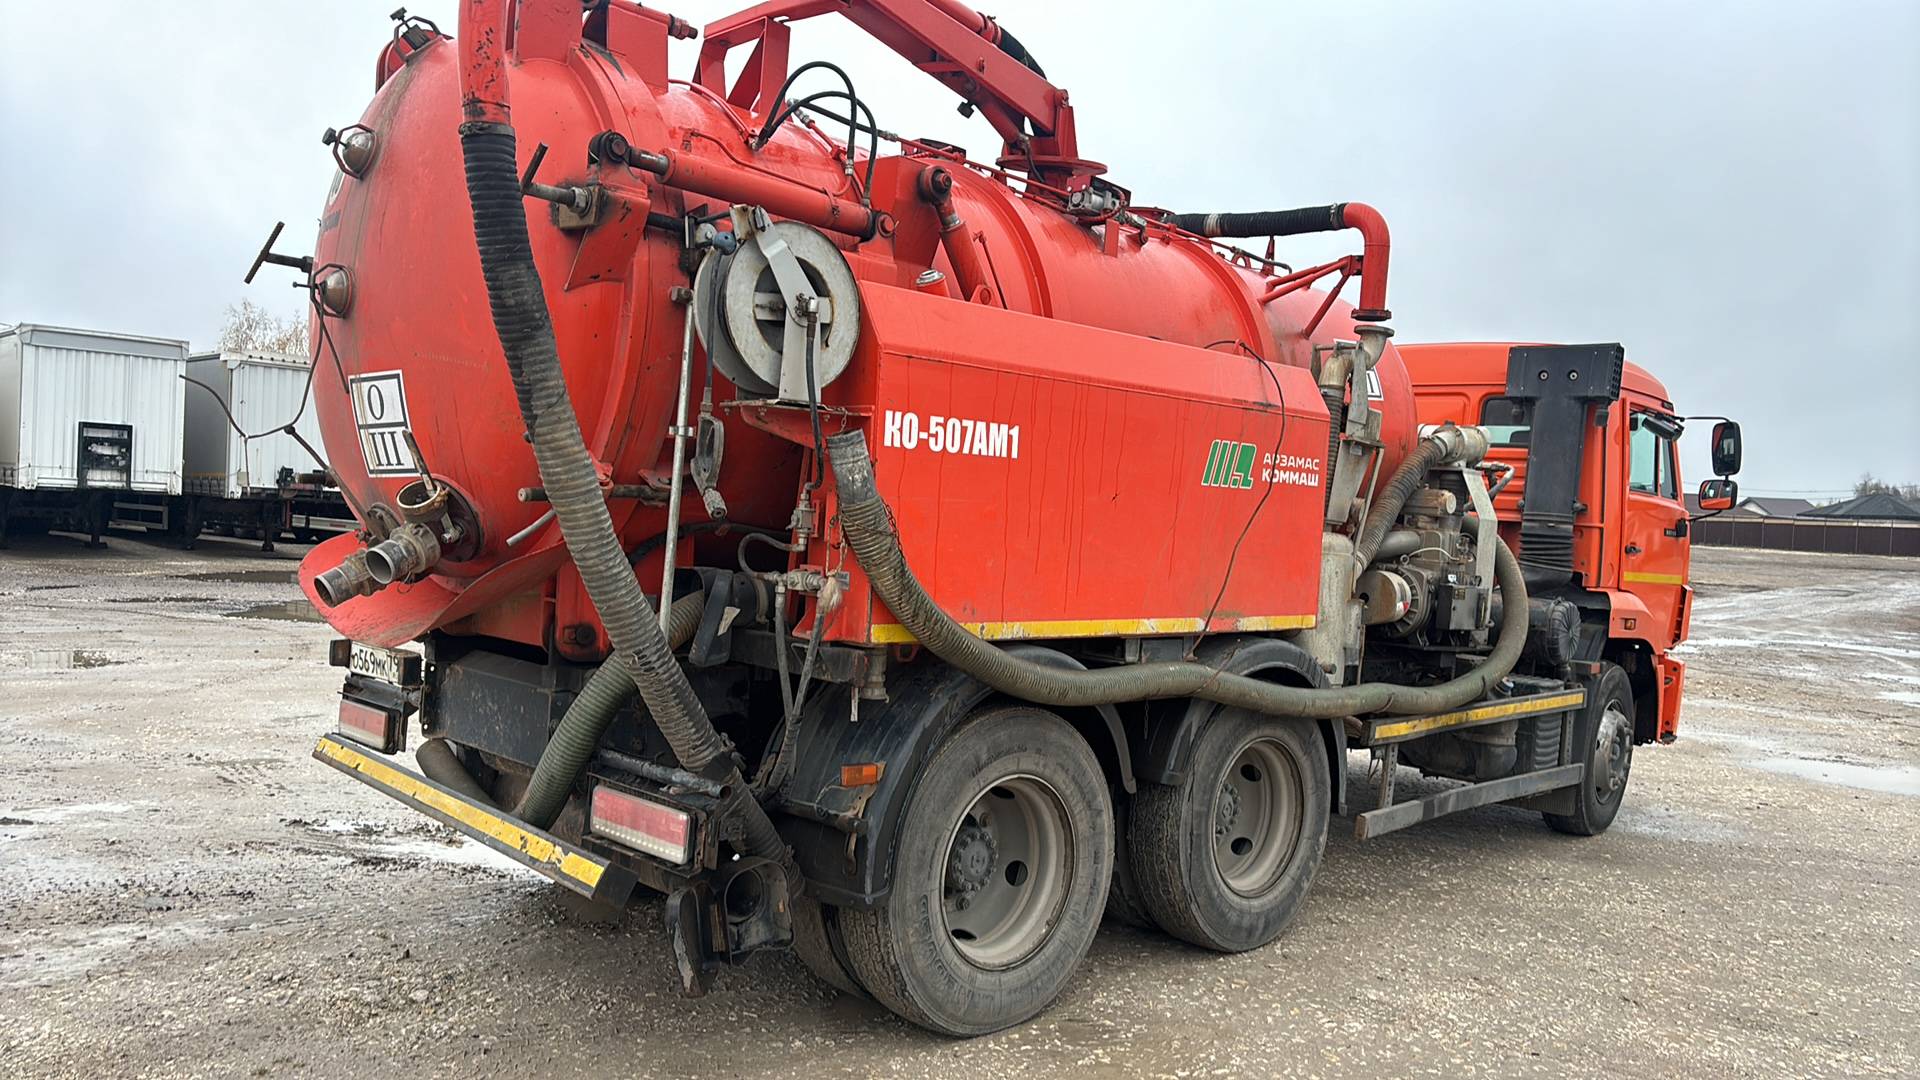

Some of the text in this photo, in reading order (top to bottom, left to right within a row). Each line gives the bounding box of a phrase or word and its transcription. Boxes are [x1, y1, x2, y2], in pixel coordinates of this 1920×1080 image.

[884, 410, 1020, 459] КО-507АМ1
[1263, 453, 1320, 470] АРЗАМАС
[1262, 468, 1319, 486] КОММАШ
